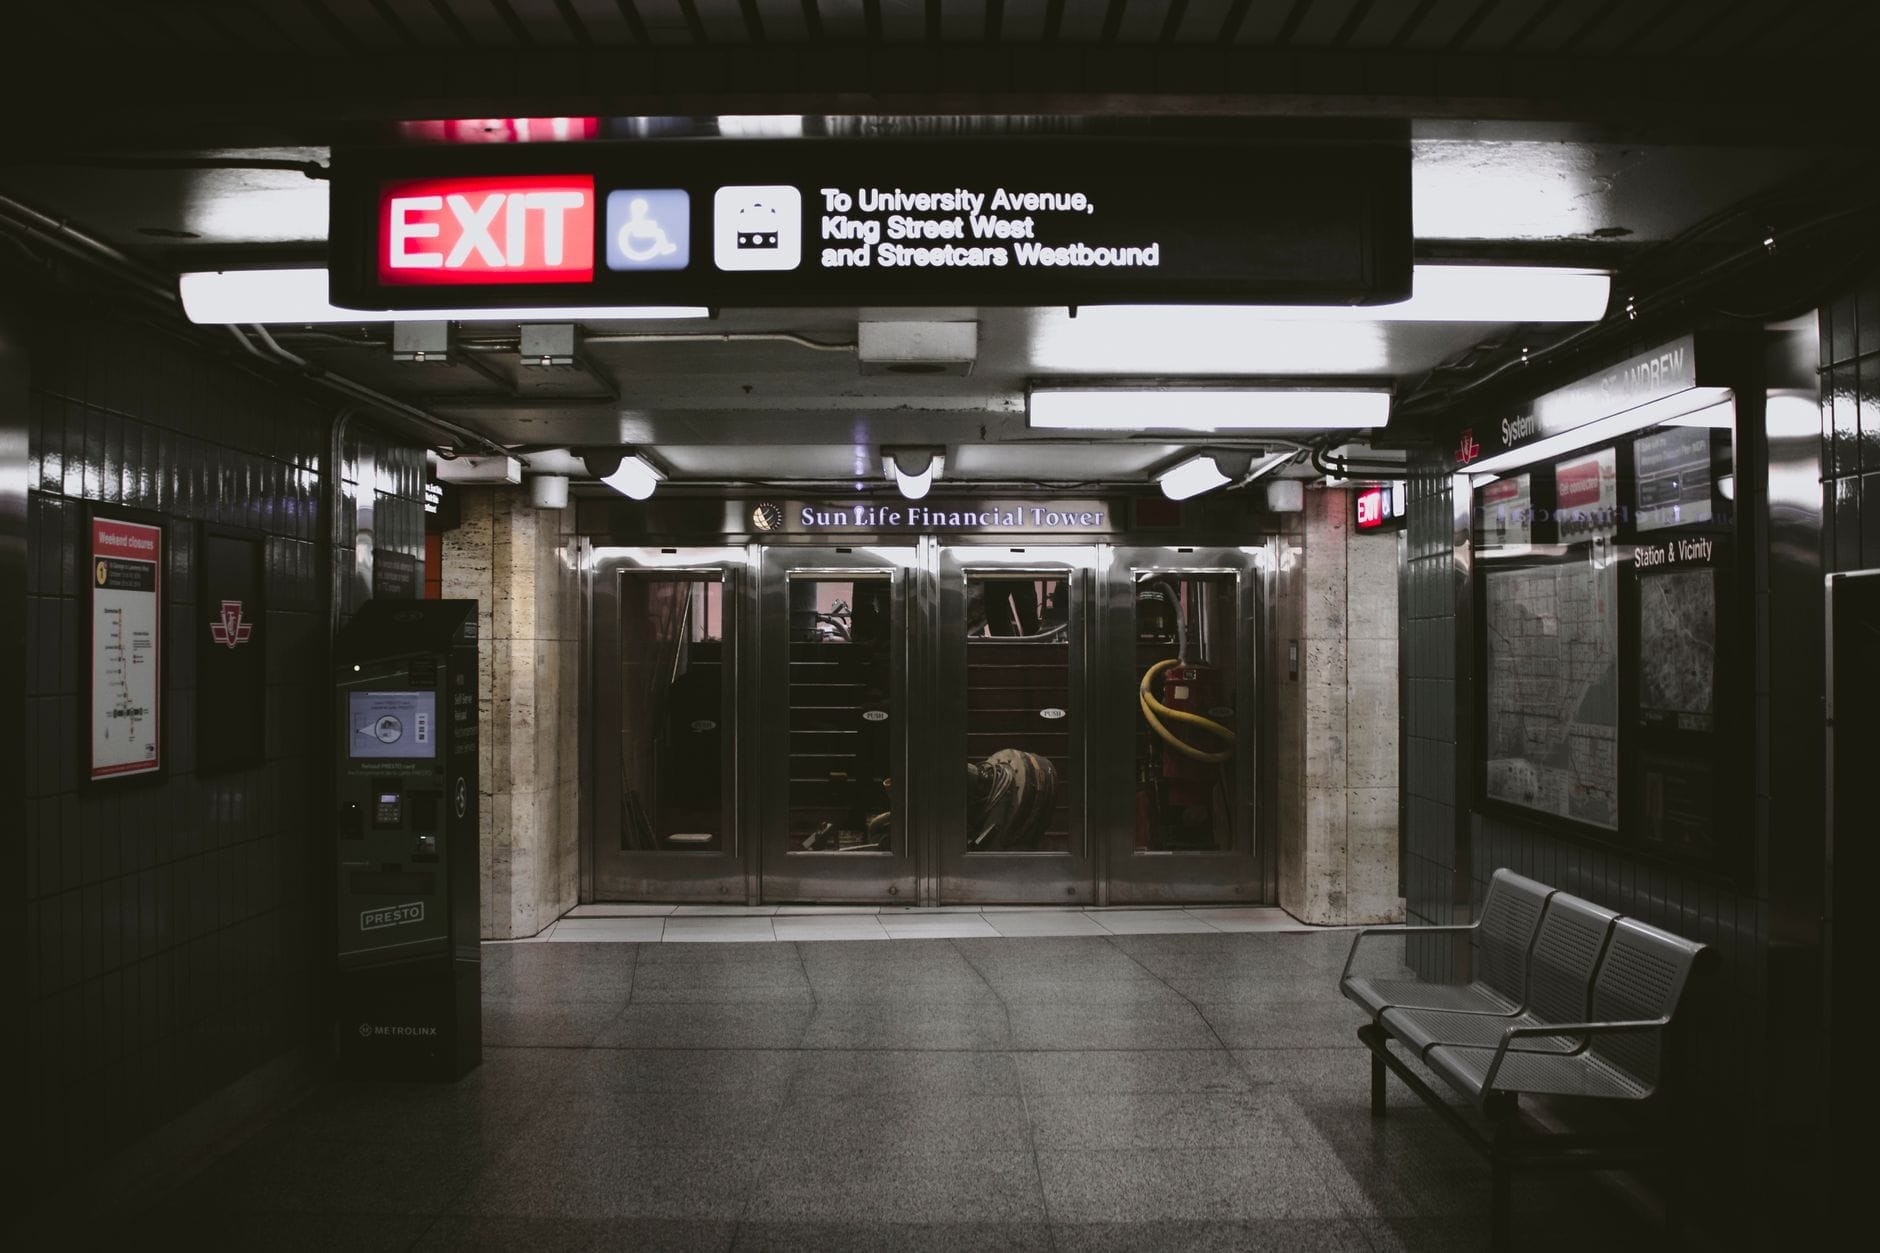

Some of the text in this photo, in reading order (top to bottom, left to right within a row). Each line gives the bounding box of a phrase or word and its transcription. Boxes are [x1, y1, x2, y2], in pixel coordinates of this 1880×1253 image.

[821, 188, 1094, 216] To University Avenue,
[389, 191, 584, 268] EXIT
[821, 214, 1035, 245] King Street West
[821, 242, 1160, 267] and Streetcars Westbound
[1501, 415, 1535, 447] System
[801, 505, 1104, 526] Sun Life Financial Tower
[1357, 492, 1381, 524] EXIT
[98, 531, 154, 551] Weekend closures
[1634, 537, 1712, 568] Station & Vicinity
[365, 907, 419, 925] PRESTO
[375, 1026, 438, 1036] METROLINX
